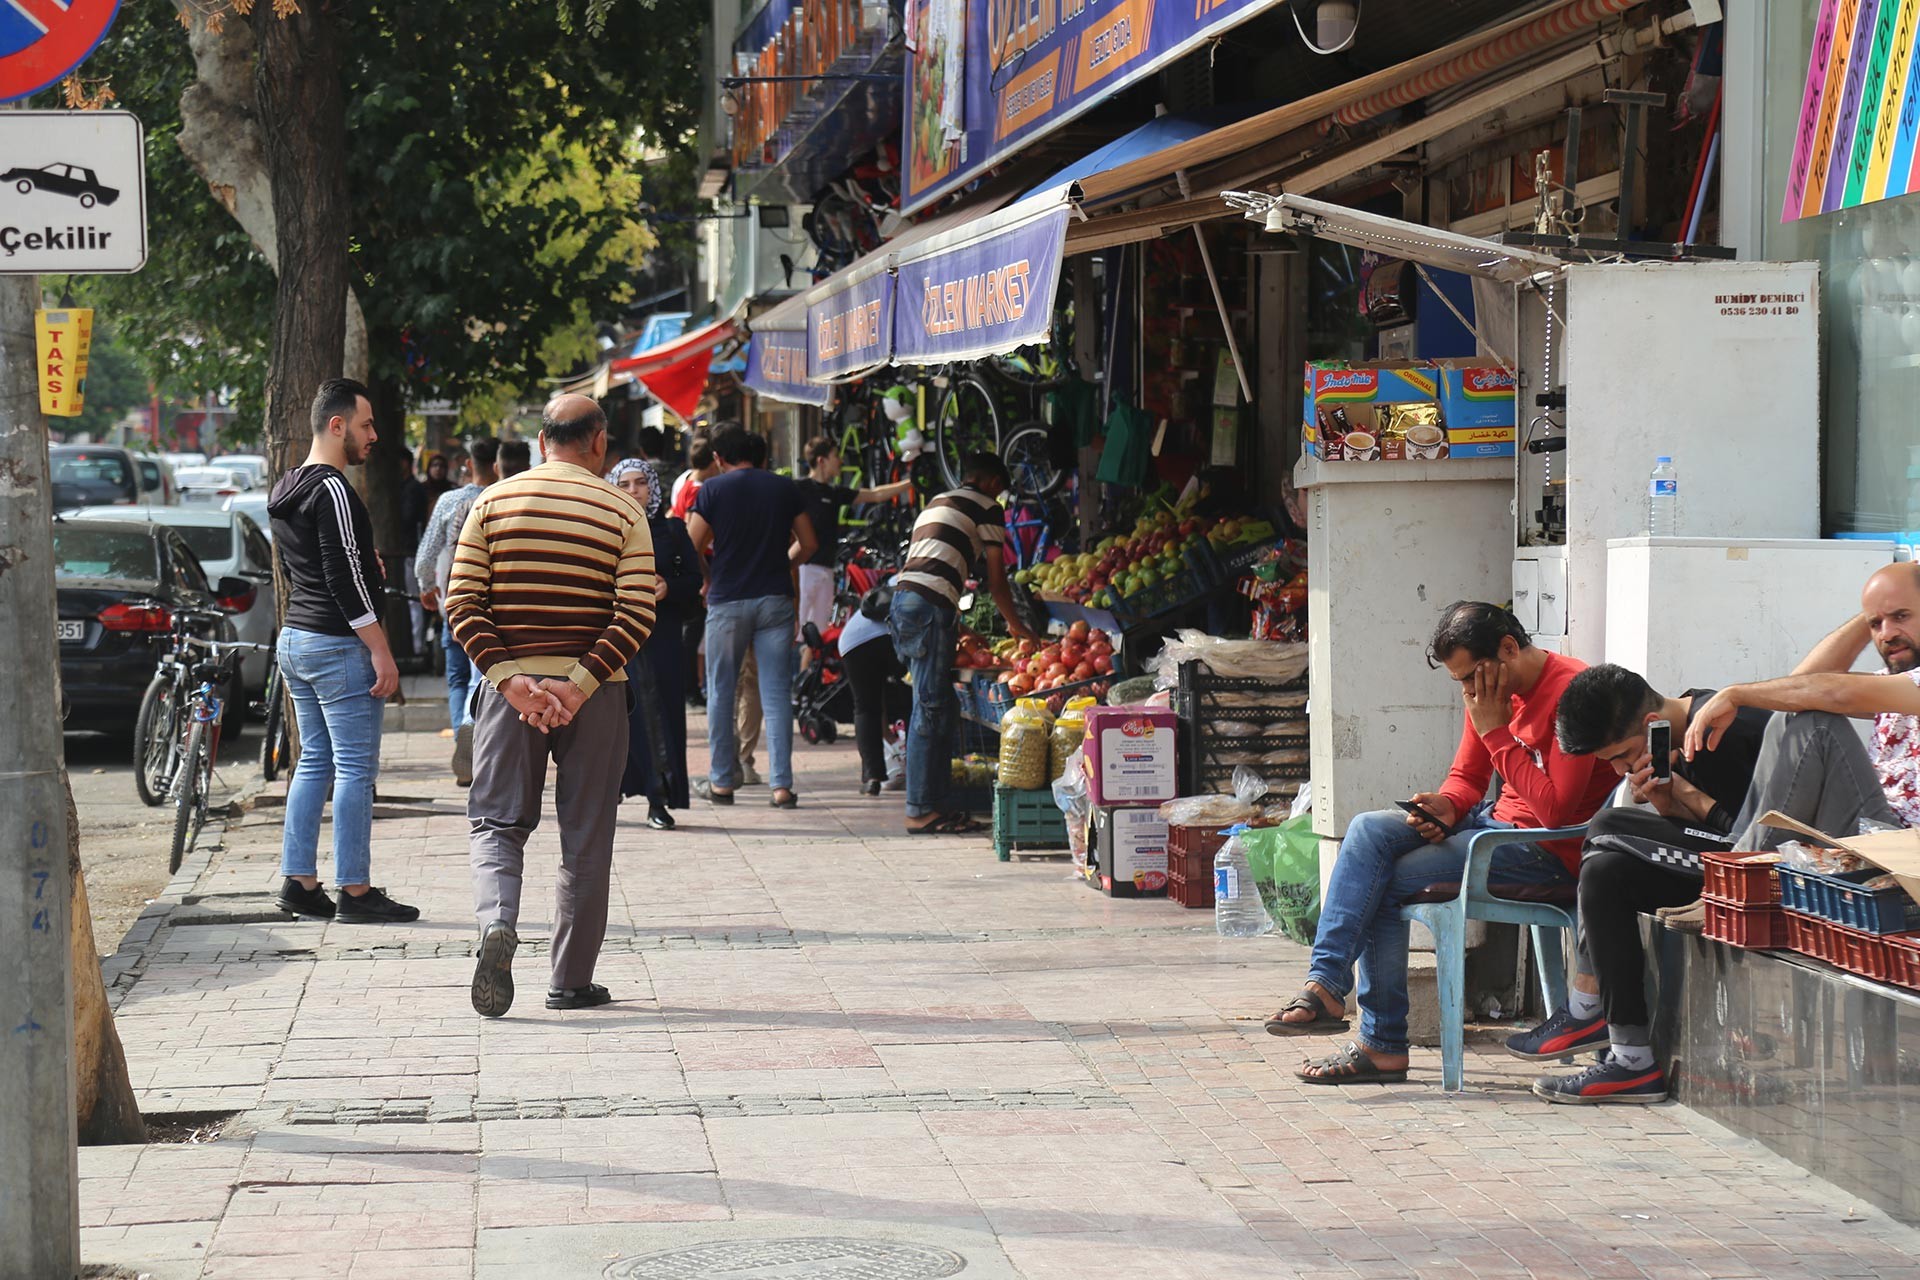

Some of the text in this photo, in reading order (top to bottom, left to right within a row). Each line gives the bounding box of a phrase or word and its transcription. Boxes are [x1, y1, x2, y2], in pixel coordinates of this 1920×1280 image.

[1112, 14, 1133, 55] GIDA
[1815, 0, 1858, 193] Temizlik Ür
[1854, 1, 1890, 185] Küçük Ev
[1902, 41, 1920, 143] Terli
[1793, 76, 1820, 210] Mutfak
[0, 226, 112, 256] Çekilir
[921, 258, 1031, 338] ÖZLEM MARKET
[1720, 306, 1799, 316] 0536 230 41 80
[1760, 291, 1805, 303] DEMİRCİ
[1317, 372, 1371, 393] Indomie
[1403, 371, 1432, 393] ORIGINAL
[57, 623, 82, 638] 951
